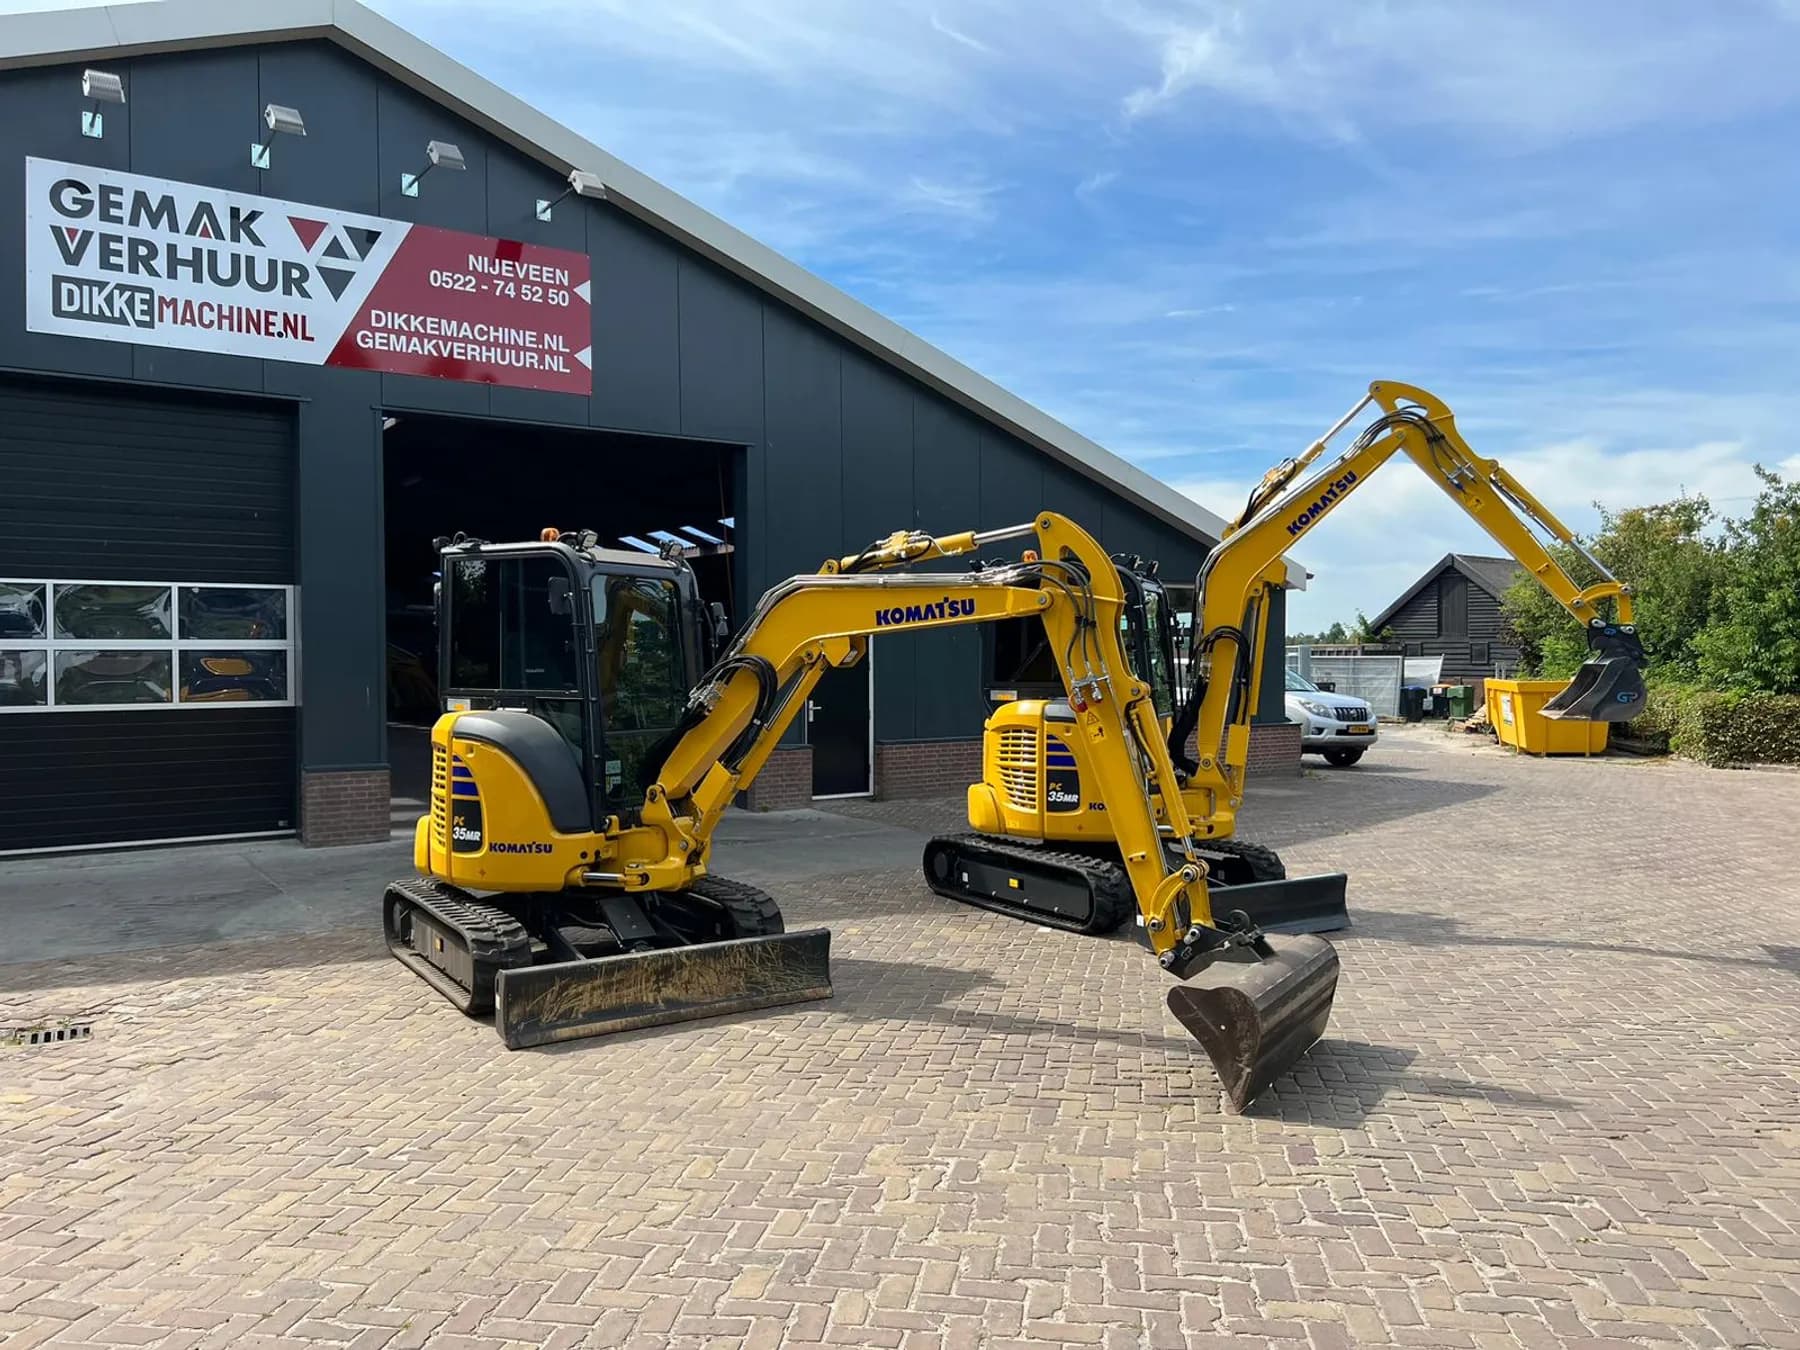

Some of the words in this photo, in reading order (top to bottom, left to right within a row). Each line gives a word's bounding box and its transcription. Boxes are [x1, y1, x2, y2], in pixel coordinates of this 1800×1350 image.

[49, 178, 266, 247] GEMAK
[49, 225, 313, 299] VERHUUR
[468, 254, 569, 286] NIJEVEEN
[429, 270, 476, 293] 0522
[493, 280, 516, 299] 74
[521, 283, 543, 303] 52
[548, 288, 569, 306] 50
[370, 309, 570, 353] DIKKEMACHINE.NL
[356, 330, 570, 373] GEMAKVERHUUR.NL
[1286, 471, 1357, 536] KOMATSU
[876, 597, 975, 626] KOMATSU
[1047, 791, 1079, 803] 35MR
[452, 826, 481, 841] 35MR
[489, 840, 553, 854] KOMATSU
